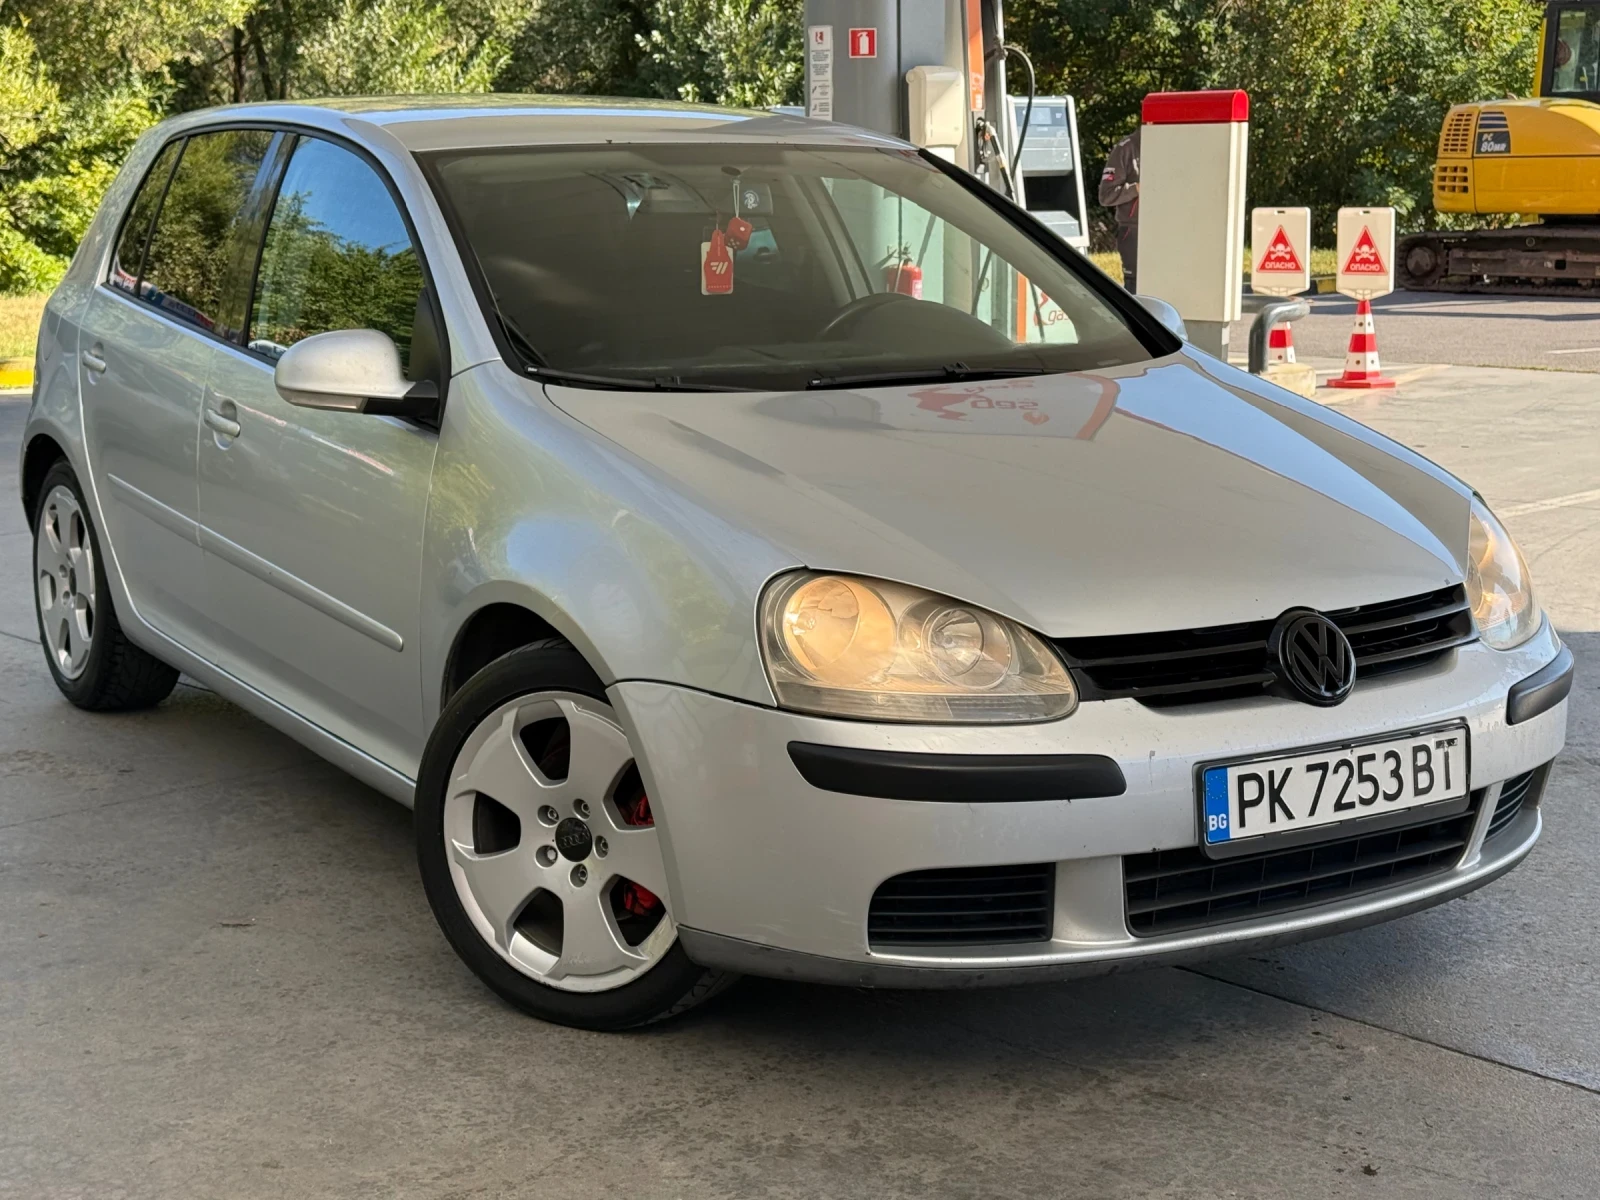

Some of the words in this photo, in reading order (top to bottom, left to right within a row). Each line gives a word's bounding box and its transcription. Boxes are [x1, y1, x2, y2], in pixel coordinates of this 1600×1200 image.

[1481, 133, 1493, 141] PC
[1265, 261, 1296, 270] ОПАСНО
[1350, 263, 1381, 272] ОПАСНО
[1047, 309, 1069, 326] ga
[1237, 766, 1296, 829] PK
[1305, 749, 1404, 818] 7253
[1411, 737, 1459, 797] BT
[1208, 813, 1228, 832] BG
